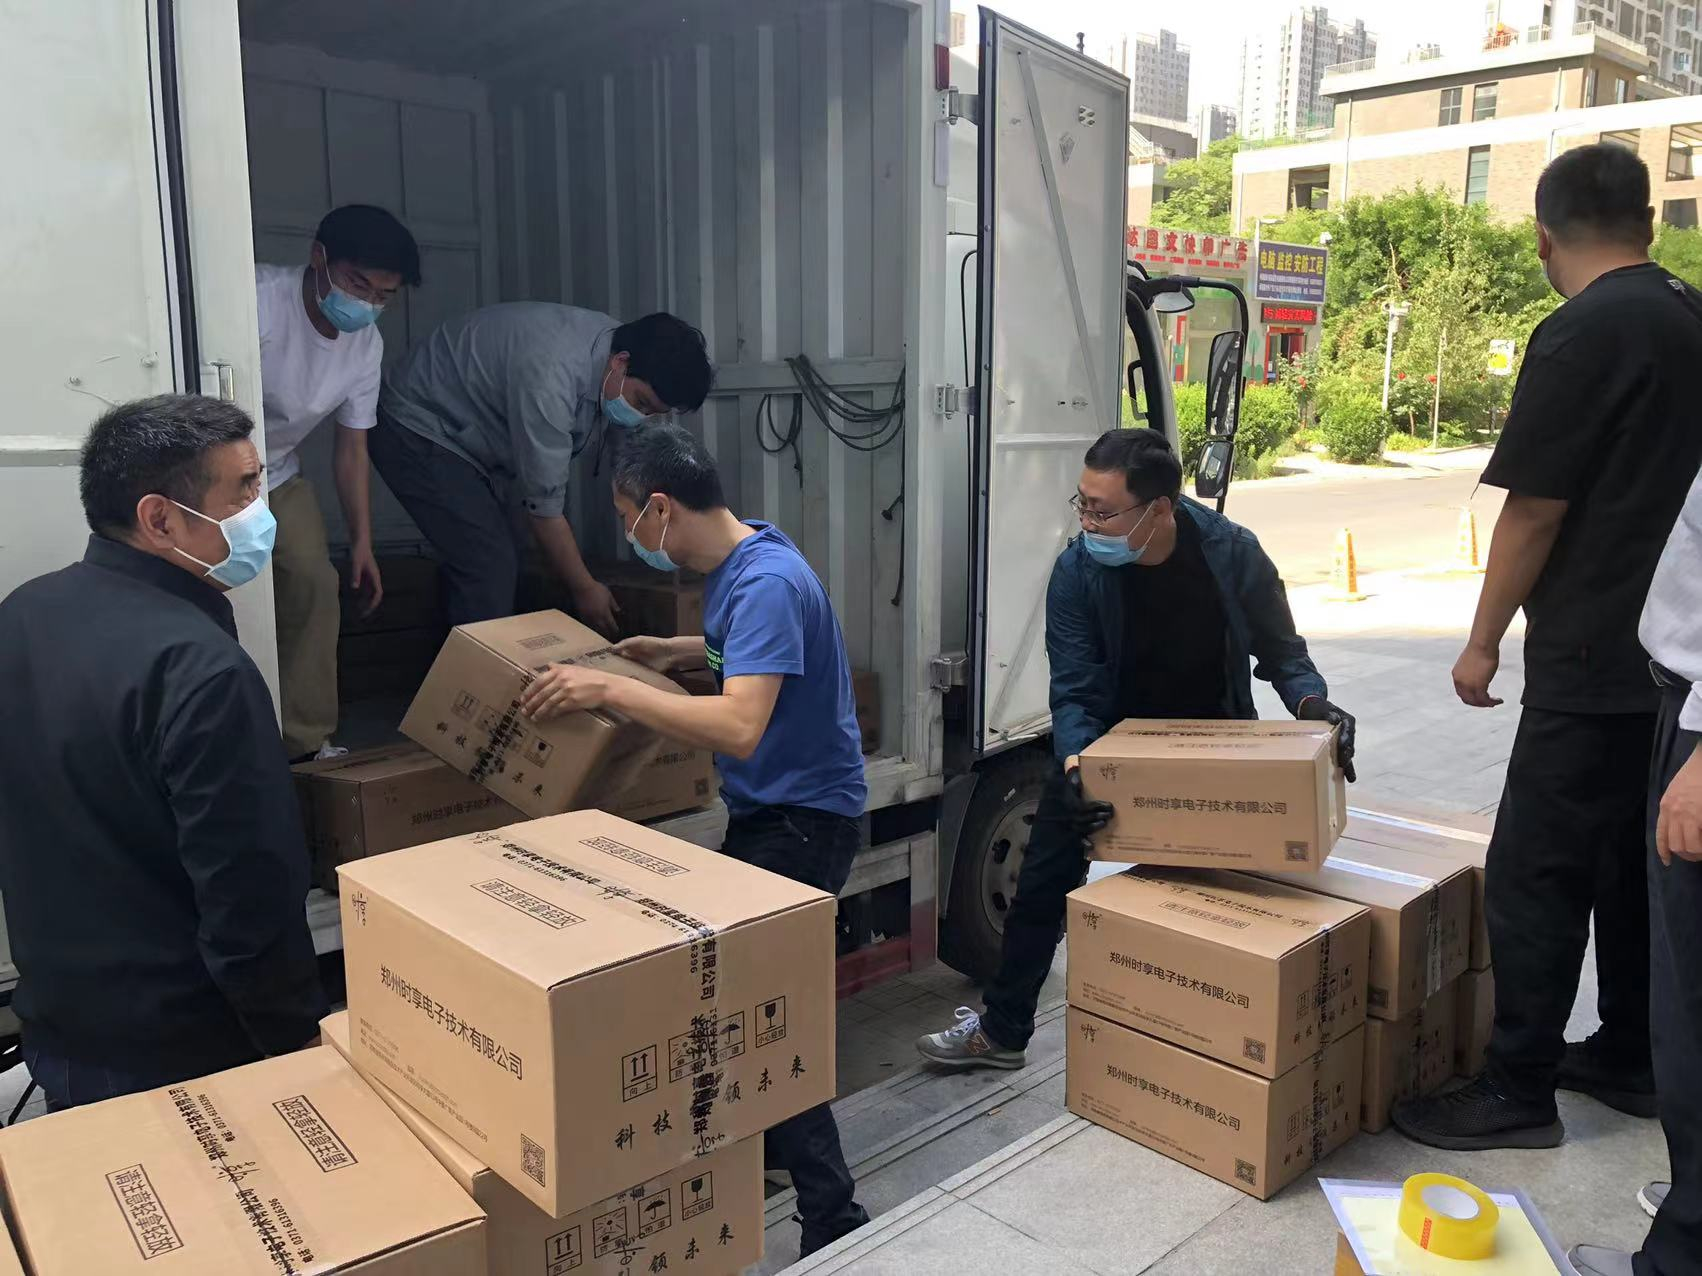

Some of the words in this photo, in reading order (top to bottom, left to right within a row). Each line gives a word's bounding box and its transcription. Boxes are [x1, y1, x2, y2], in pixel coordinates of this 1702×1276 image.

[1133, 797, 1287, 815] 郑州时享电子技术有限公司
[1110, 951, 1249, 1009] 郑州时享电子技术有限公司
[380, 964, 523, 1081] 郑州时享电子技术有限公司
[1106, 1064, 1241, 1131] 郑州时享电子技术有限公司
[279, 1098, 348, 1168] 请注意轻拿轻放
[114, 1169, 176, 1255] 请注意轻拿轻放
